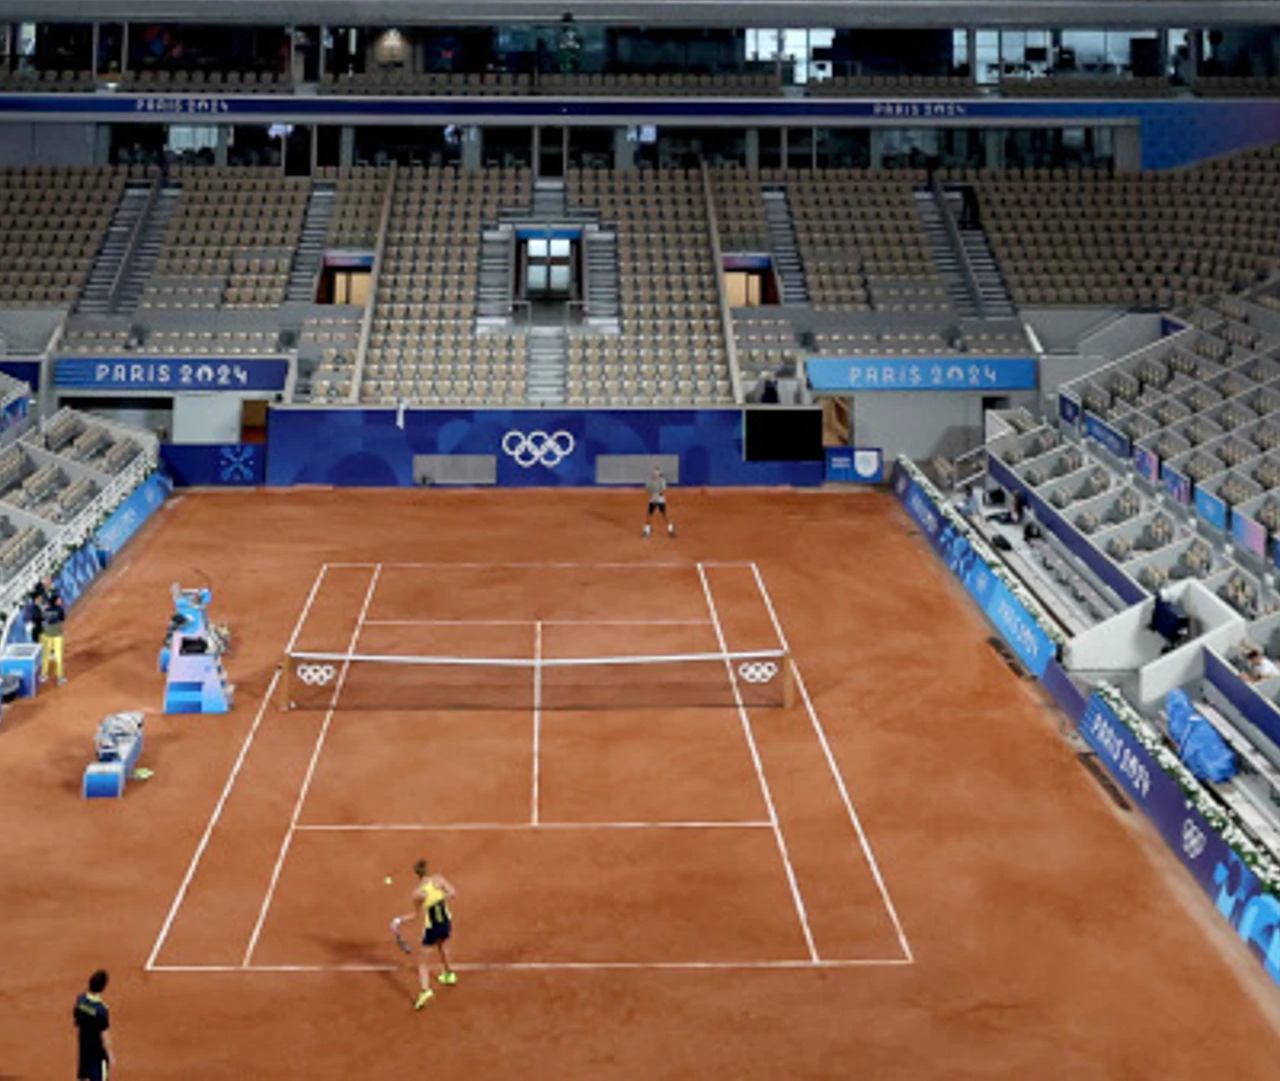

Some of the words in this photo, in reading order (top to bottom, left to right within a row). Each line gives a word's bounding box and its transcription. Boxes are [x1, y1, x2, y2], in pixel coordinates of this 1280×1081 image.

[94, 363, 171, 383] PARIS
[179, 364, 248, 384] 2024
[848, 365, 921, 384] PARIS
[930, 365, 997, 384] 2024
